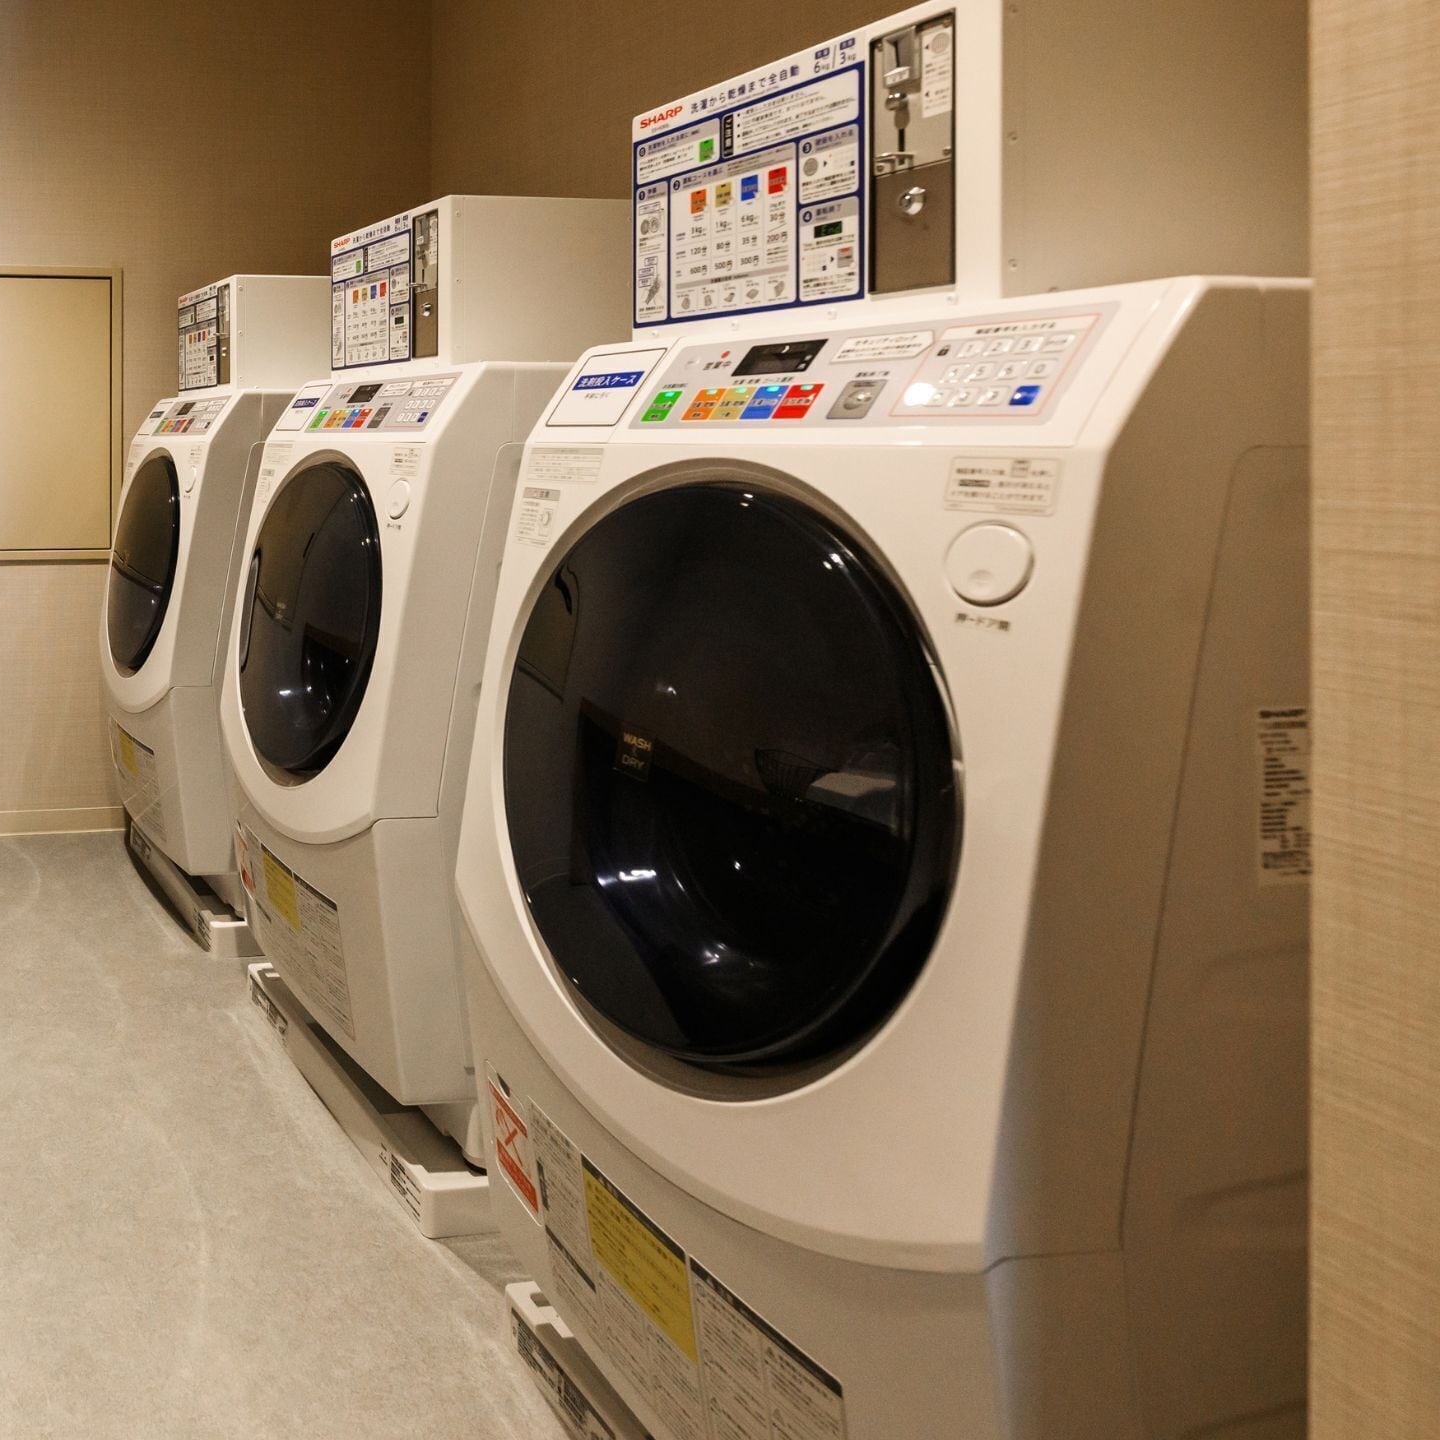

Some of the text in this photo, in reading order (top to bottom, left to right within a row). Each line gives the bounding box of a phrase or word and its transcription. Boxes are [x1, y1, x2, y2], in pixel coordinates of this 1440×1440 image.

[691, 64, 800, 114] 洗濯から乾燥まで全自動
[640, 105, 683, 129] SHARP
[333, 237, 351, 249] SHARP
[577, 374, 638, 389] 洗剤投入ケース
[623, 731, 653, 751] WASH
[621, 754, 646, 769] DRY
